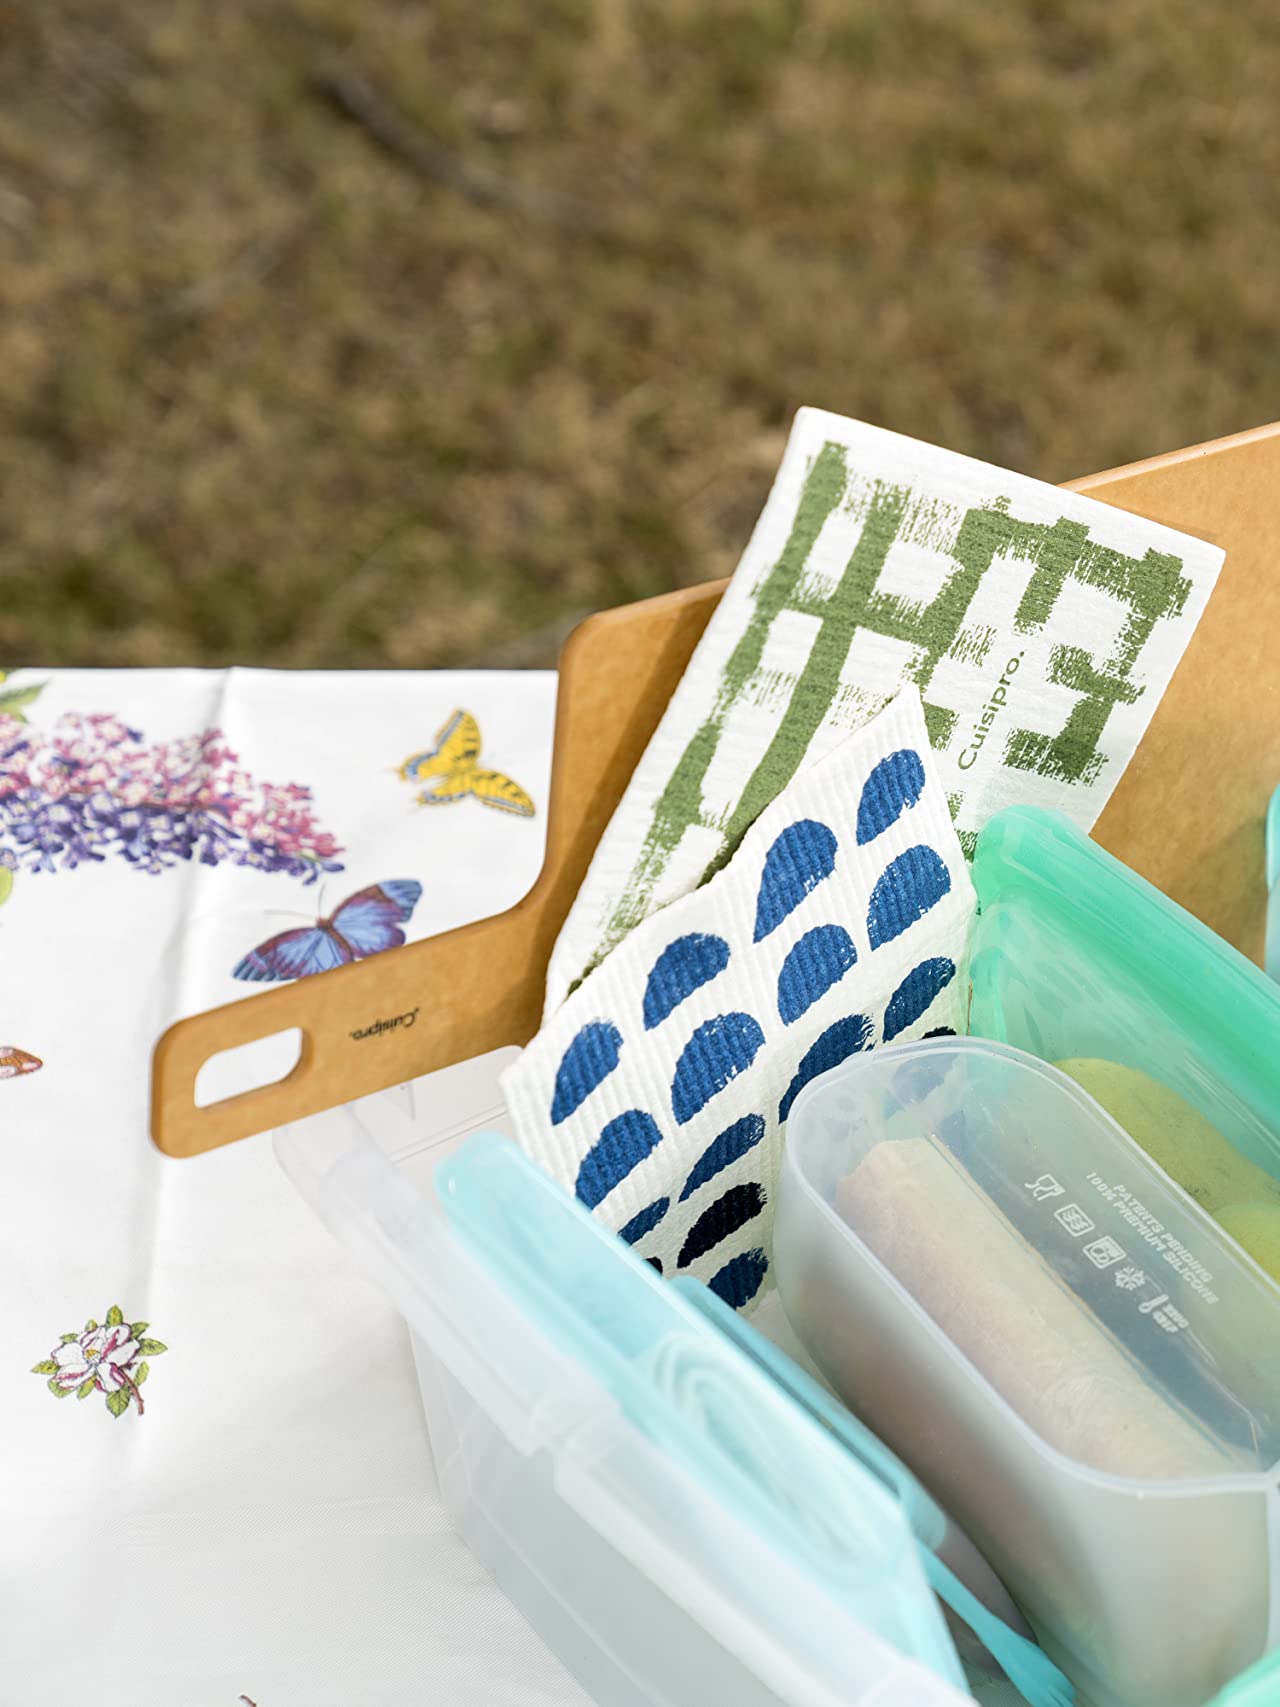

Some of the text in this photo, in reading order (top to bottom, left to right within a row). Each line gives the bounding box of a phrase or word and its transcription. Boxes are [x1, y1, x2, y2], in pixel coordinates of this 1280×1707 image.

[958, 651, 1024, 770] Cuisipro.
[1086, 1172, 1219, 1304] 100% PREMIUM SILICONE
[1113, 1184, 1213, 1283] PATENTS PENDING
